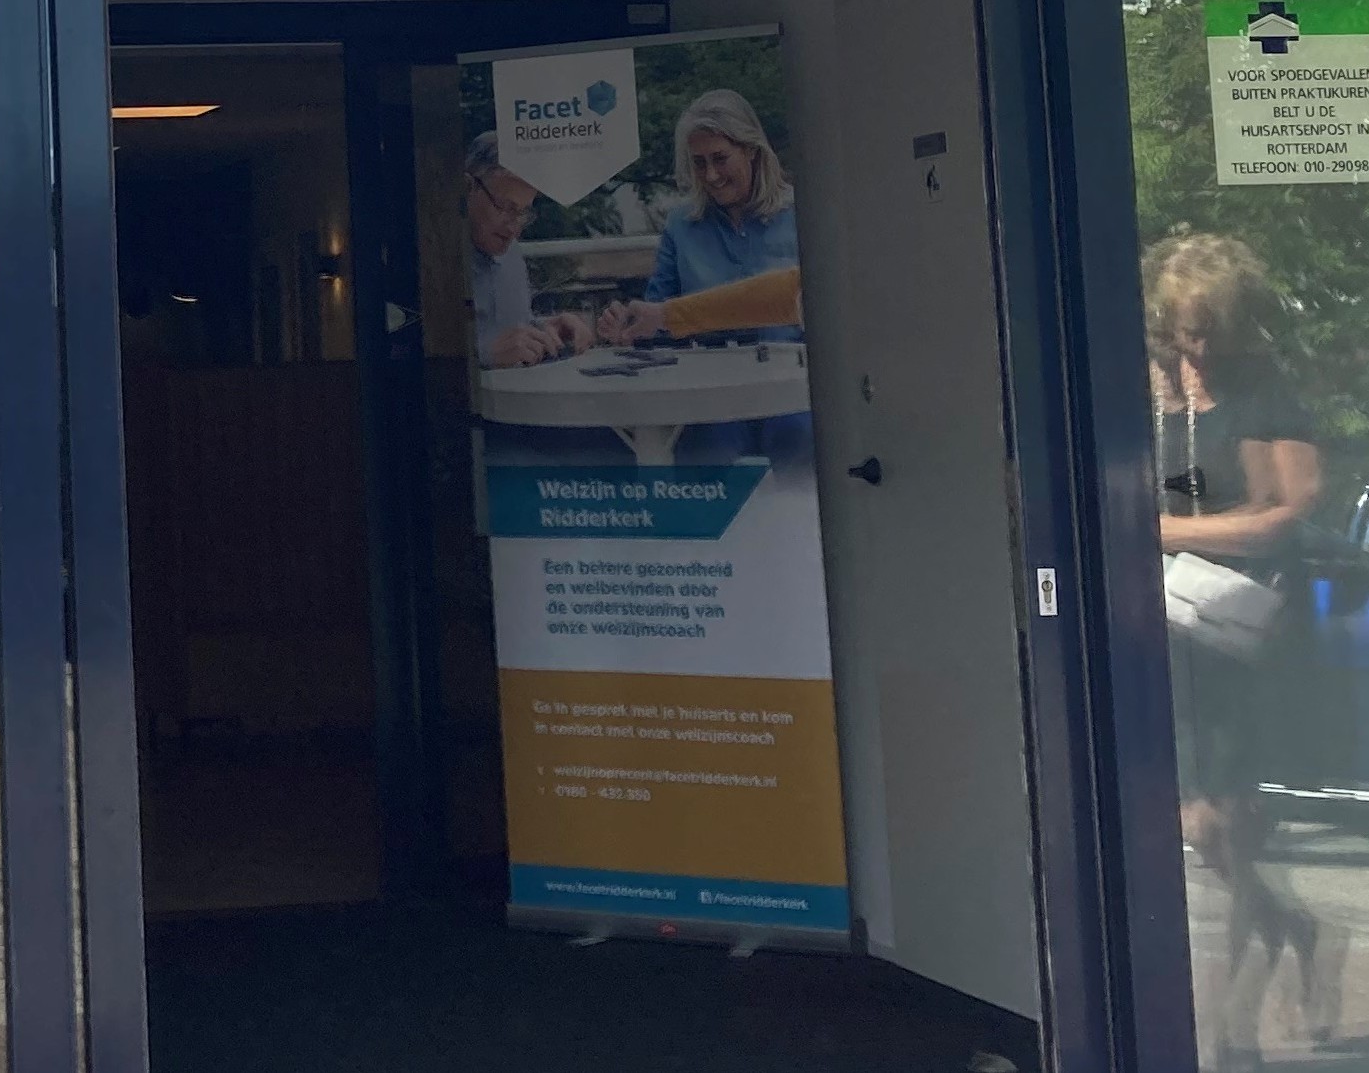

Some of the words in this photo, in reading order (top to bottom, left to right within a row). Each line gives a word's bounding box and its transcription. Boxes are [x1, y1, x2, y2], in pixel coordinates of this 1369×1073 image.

[1228, 70, 1266, 82] VOOR
[1232, 88, 1277, 100] BUITEN
[514, 96, 582, 121] Facet
[1273, 106, 1300, 118] BELT
[1305, 106, 1315, 117] U
[1320, 105, 1336, 117] DE
[515, 120, 602, 141] Ridderkerk
[1241, 123, 1353, 137] HUISARTSENPOST
[1357, 123, 1369, 135] IN
[1267, 142, 1348, 155] ROTTERDAM
[1232, 162, 1299, 174] TELEFOON:
[537, 479, 616, 501] Welzijn
[622, 484, 647, 501] op
[653, 479, 728, 502] Recept
[539, 507, 654, 528] Ridderkerk
[543, 559, 574, 575] Een
[579, 560, 633, 576] betere
[637, 560, 733, 578] gezondheid
[545, 583, 566, 595] en
[570, 581, 675, 597] welbevinden
[679, 583, 719, 598] door
[546, 601, 567, 615] de
[572, 601, 690, 619] ondersteuning
[695, 605, 725, 618] van
[547, 622, 588, 635] onze
[592, 621, 706, 639] welzijnscoach
